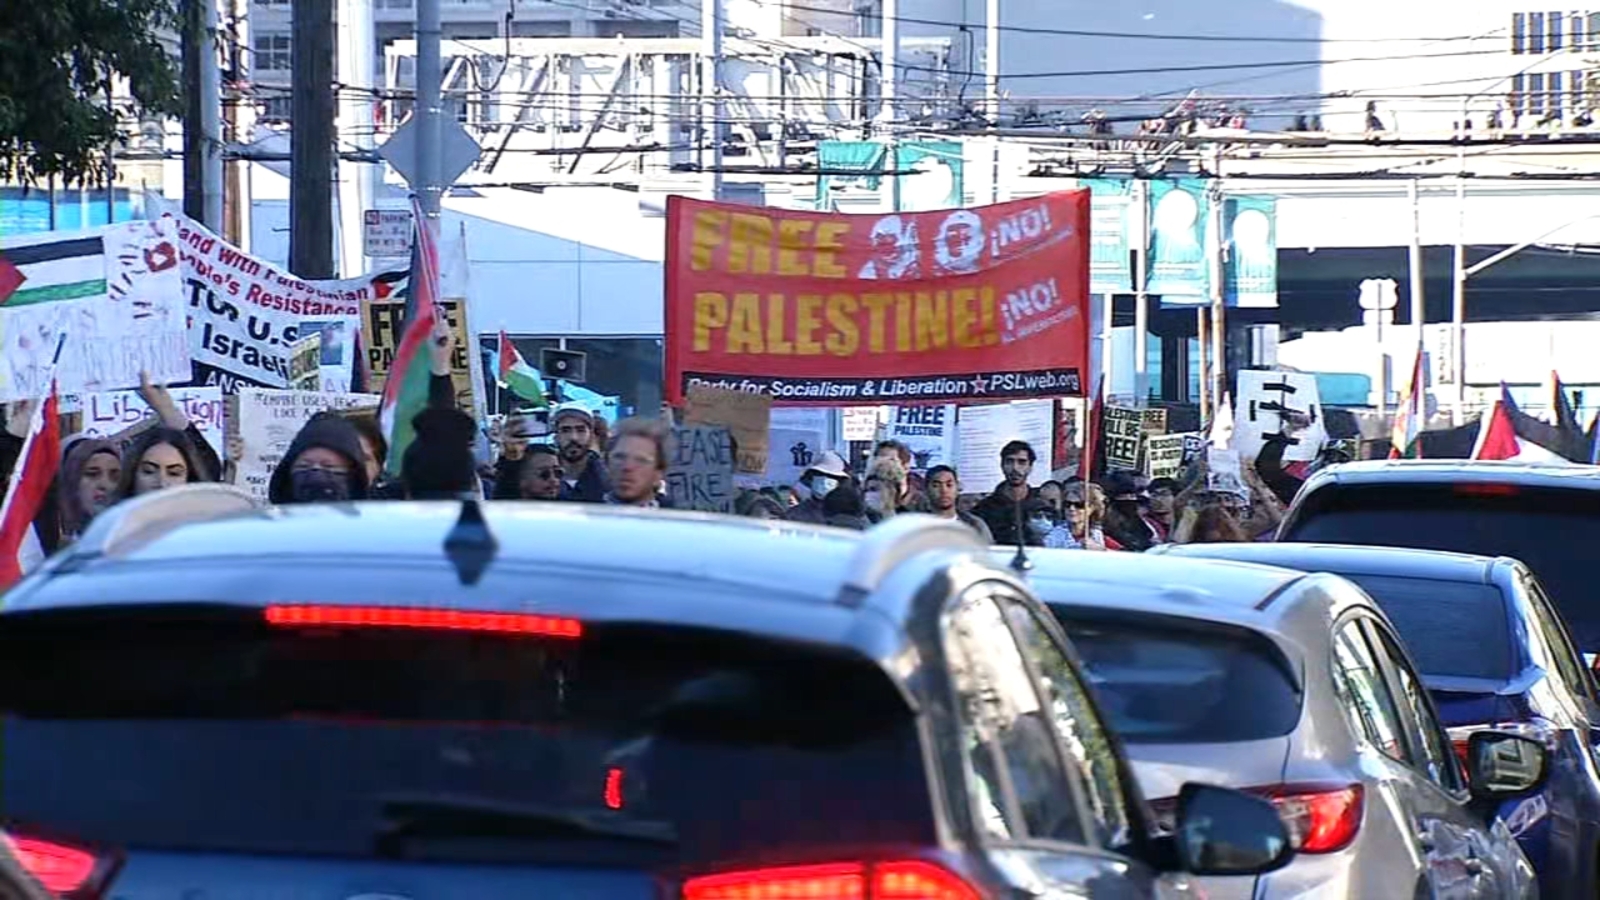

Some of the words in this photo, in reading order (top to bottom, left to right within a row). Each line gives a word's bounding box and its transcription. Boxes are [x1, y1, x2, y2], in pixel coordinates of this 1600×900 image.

[690, 209, 850, 279] FREE
[990, 203, 1052, 256] ¡NO!
[693, 284, 999, 357] PALESTINE!
[1001, 277, 1061, 331] ¡NO!
[202, 322, 290, 381] Israeli
[770, 380, 857, 397] Socialism
[862, 381, 875, 396] &
[879, 378, 967, 396] Liberation
[990, 371, 1079, 392] PSLweb.org
[894, 425, 943, 437] PALESTINE
[895, 405, 945, 425] FREE
[666, 472, 725, 502] FIRE
